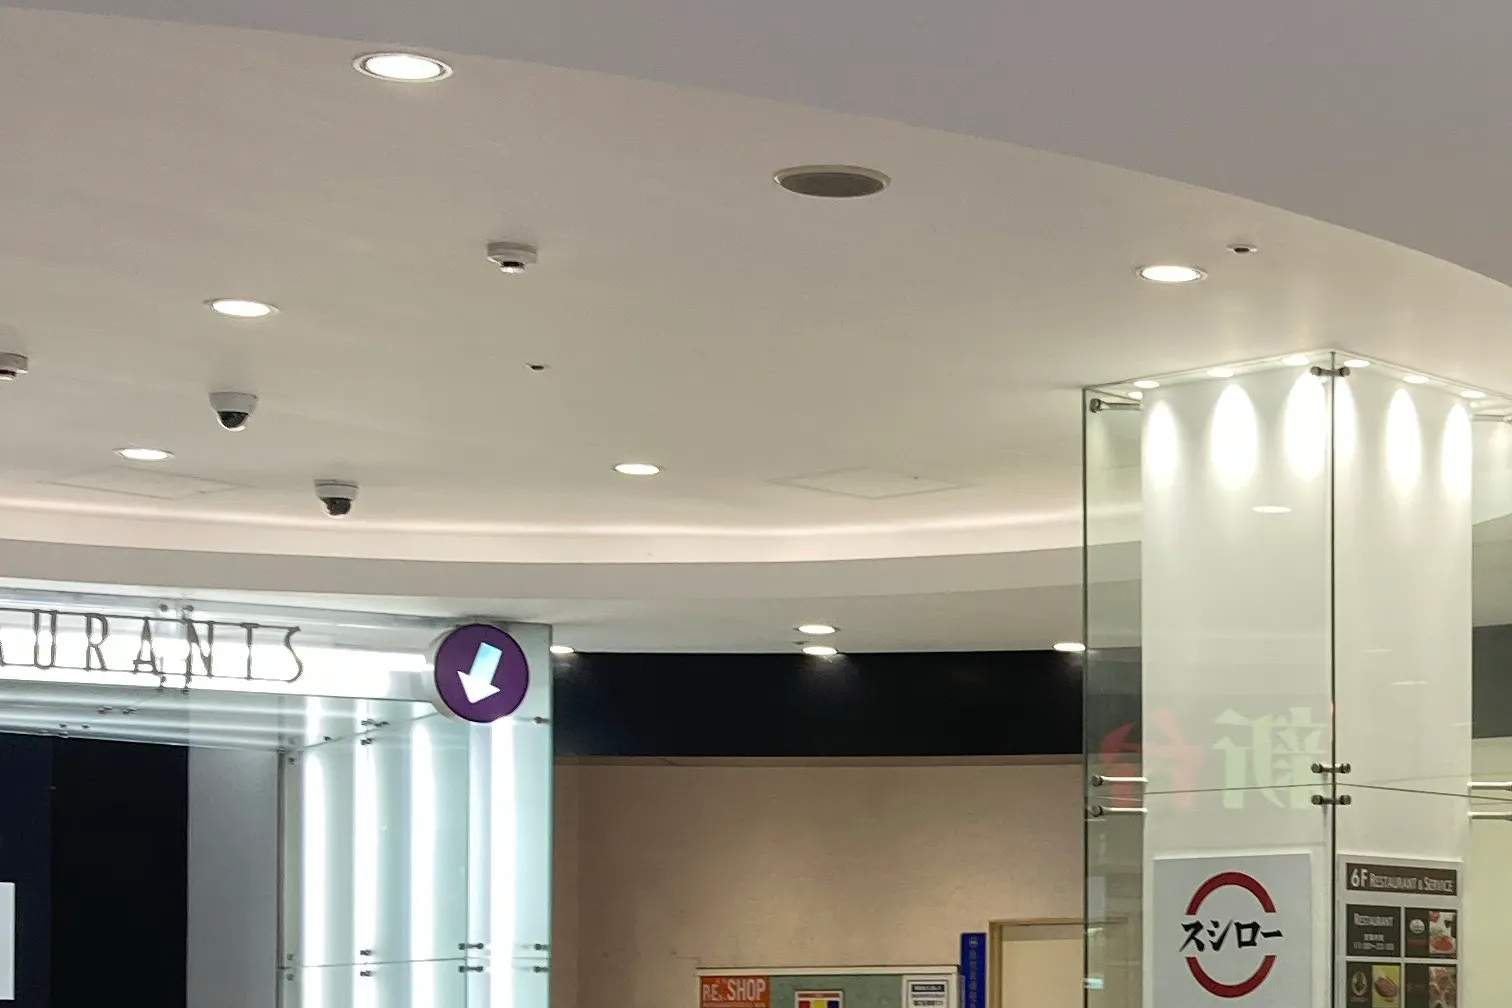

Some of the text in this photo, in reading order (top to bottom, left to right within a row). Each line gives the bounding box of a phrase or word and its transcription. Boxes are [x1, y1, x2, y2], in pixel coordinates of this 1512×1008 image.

[0, 607, 303, 683] URANTS
[1350, 868, 1368, 888] 6F
[1179, 919, 1284, 952] スシロー
[727, 978, 766, 1002] SHOP
